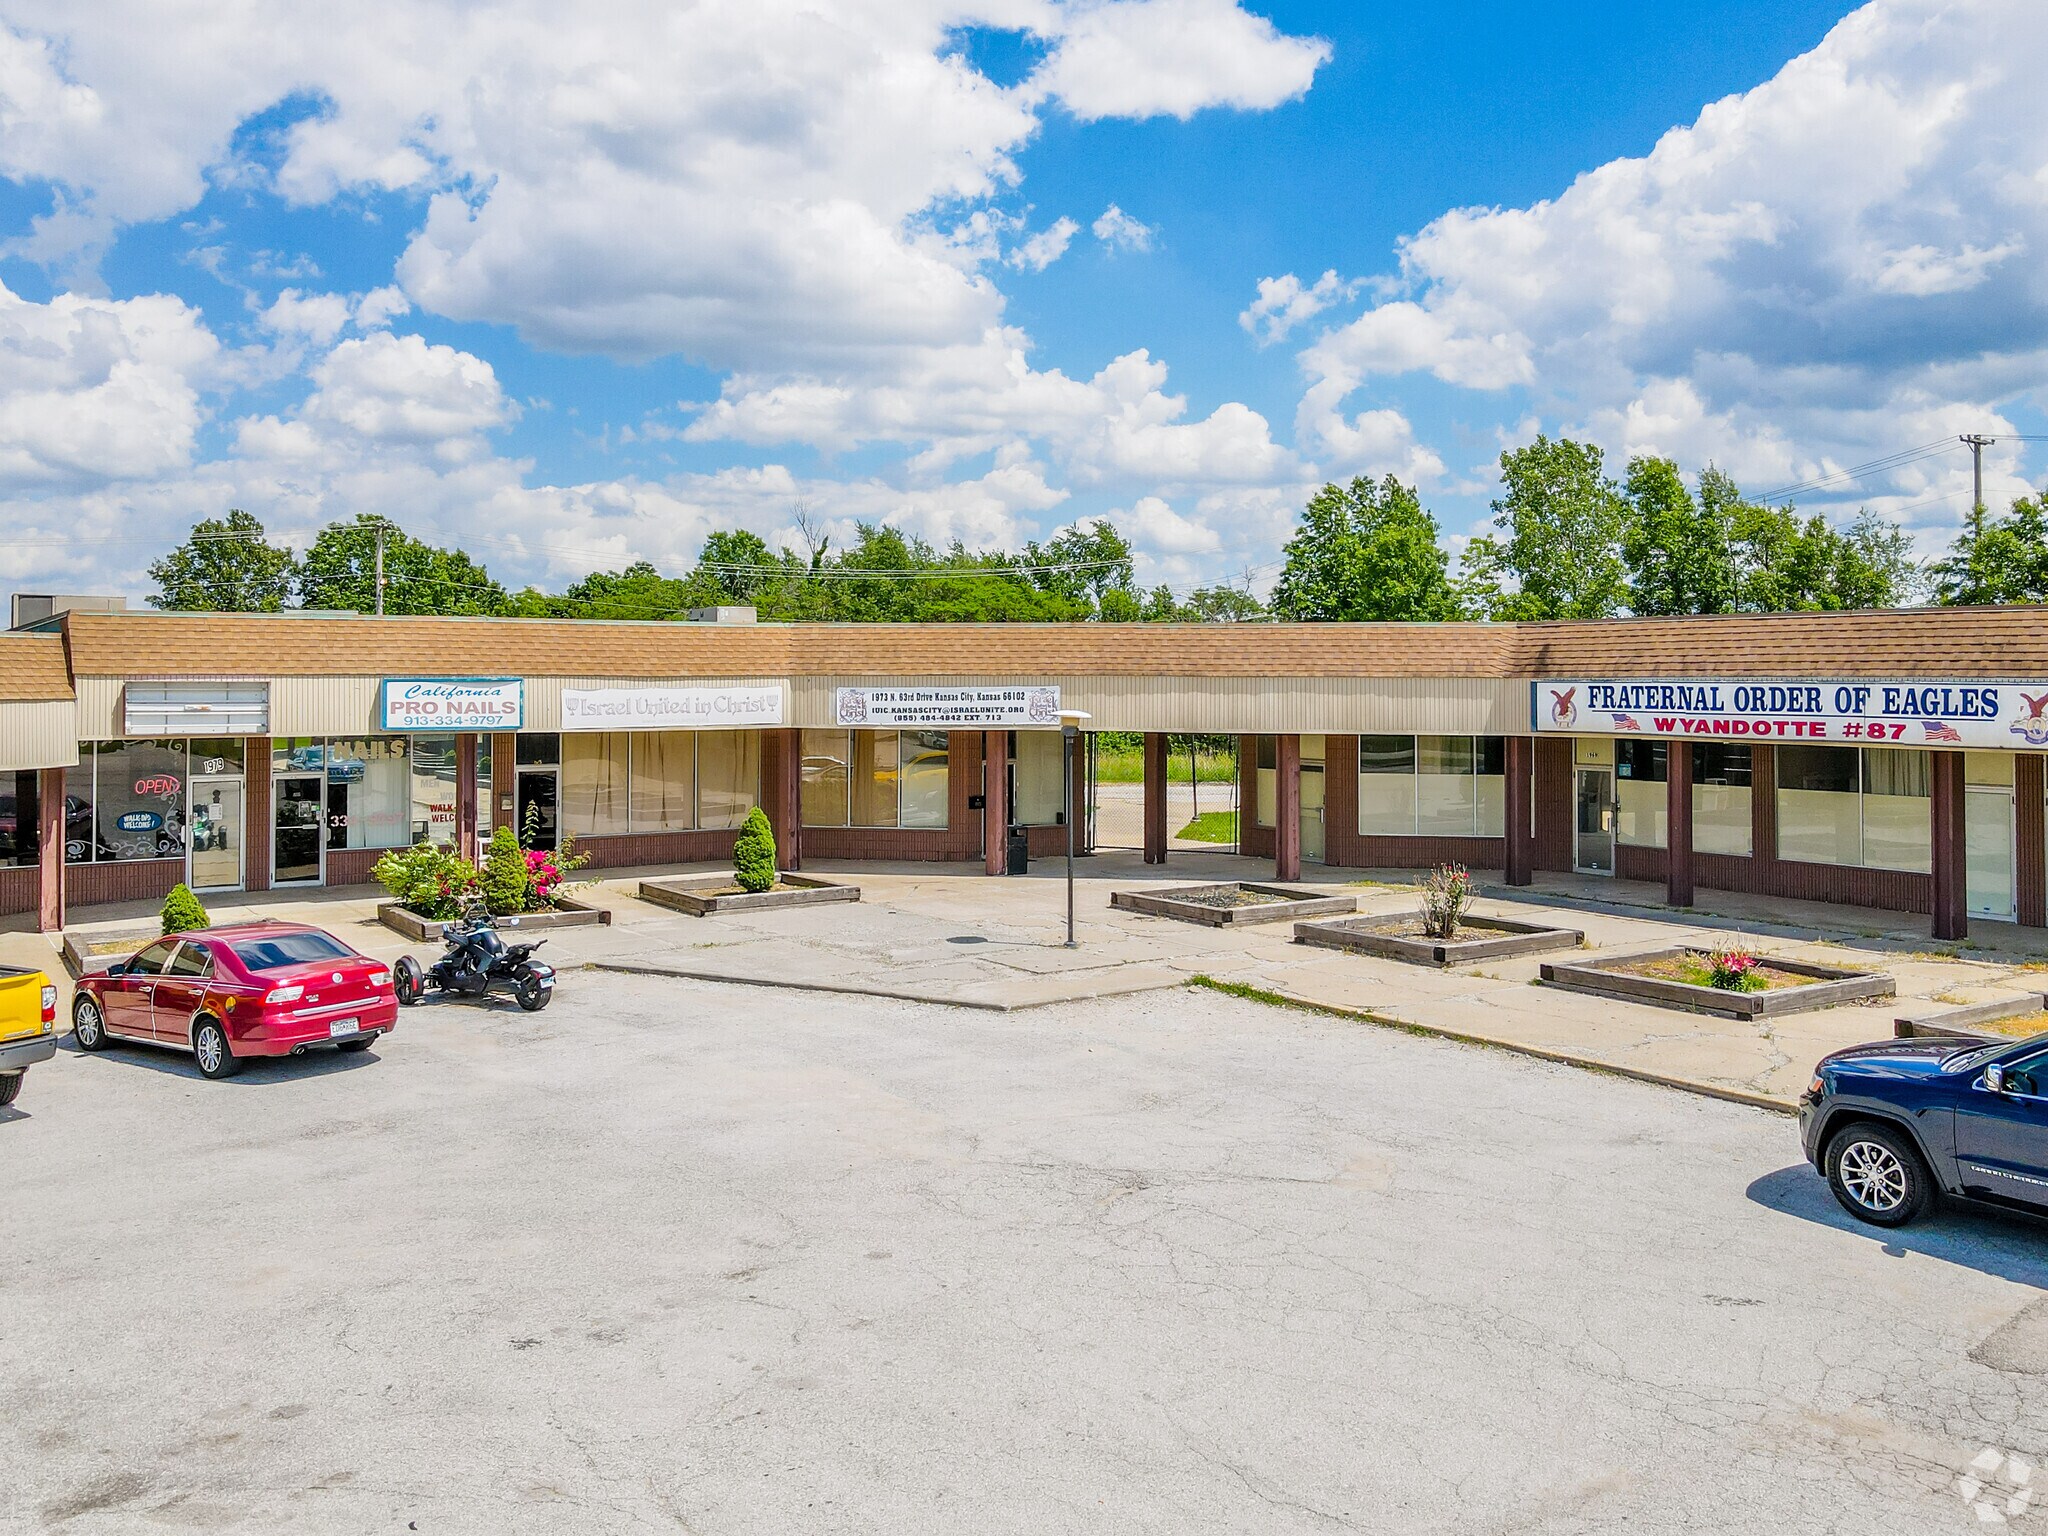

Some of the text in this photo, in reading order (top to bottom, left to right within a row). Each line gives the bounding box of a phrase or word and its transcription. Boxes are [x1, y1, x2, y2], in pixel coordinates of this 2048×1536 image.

[404, 684, 503, 700] California
[916, 692, 933, 701] Drive
[934, 692, 959, 701] Kansas
[977, 692, 1001, 701] Kansas
[390, 701, 516, 714] PRO NAILS
[579, 695, 766, 718] Israel United in Christ
[1588, 685, 1999, 718] FRATERNAL ORDER OF EAGLES
[403, 715, 504, 726] 913-334-9797
[1653, 717, 1907, 740] WYANDOTTE #87
[333, 740, 406, 759] NAILS
[203, 757, 224, 774] 1979
[135, 780, 173, 794] OPEN
[431, 813, 457, 823] WELC
